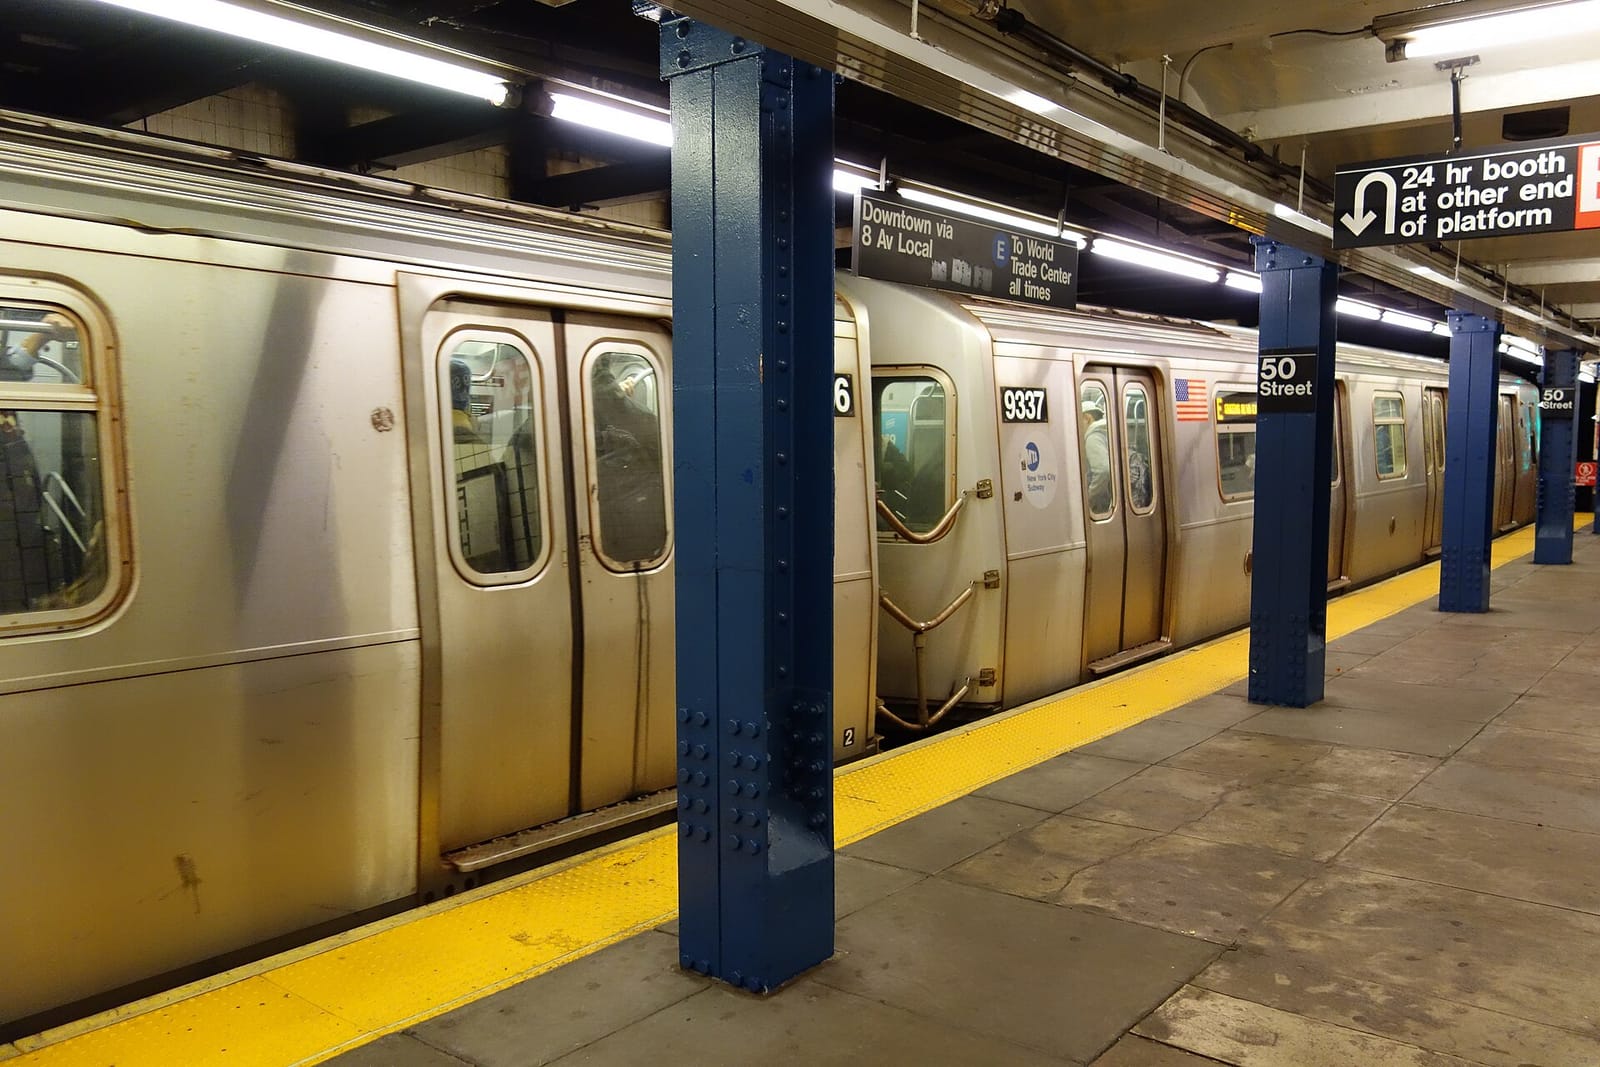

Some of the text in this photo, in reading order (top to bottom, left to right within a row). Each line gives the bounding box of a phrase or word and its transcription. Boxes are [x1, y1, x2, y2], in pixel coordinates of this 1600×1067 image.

[1402, 151, 1566, 190] 24 hr booth
[1401, 174, 1574, 213] at other end
[862, 199, 953, 241] Downtown via
[1400, 207, 1552, 239] of platform
[861, 225, 933, 259] 8 Av Local
[996, 240, 1006, 260] E
[1011, 235, 1054, 262] To World
[1011, 256, 1037, 278] Trade
[1041, 263, 1072, 286] Center
[1009, 280, 1051, 301] all times
[1260, 357, 1296, 381] 50
[1260, 381, 1313, 396] Street
[1543, 390, 1564, 401] 50
[1004, 389, 1045, 420] 9337
[1542, 401, 1573, 410] Street
[844, 729, 853, 746] 2
